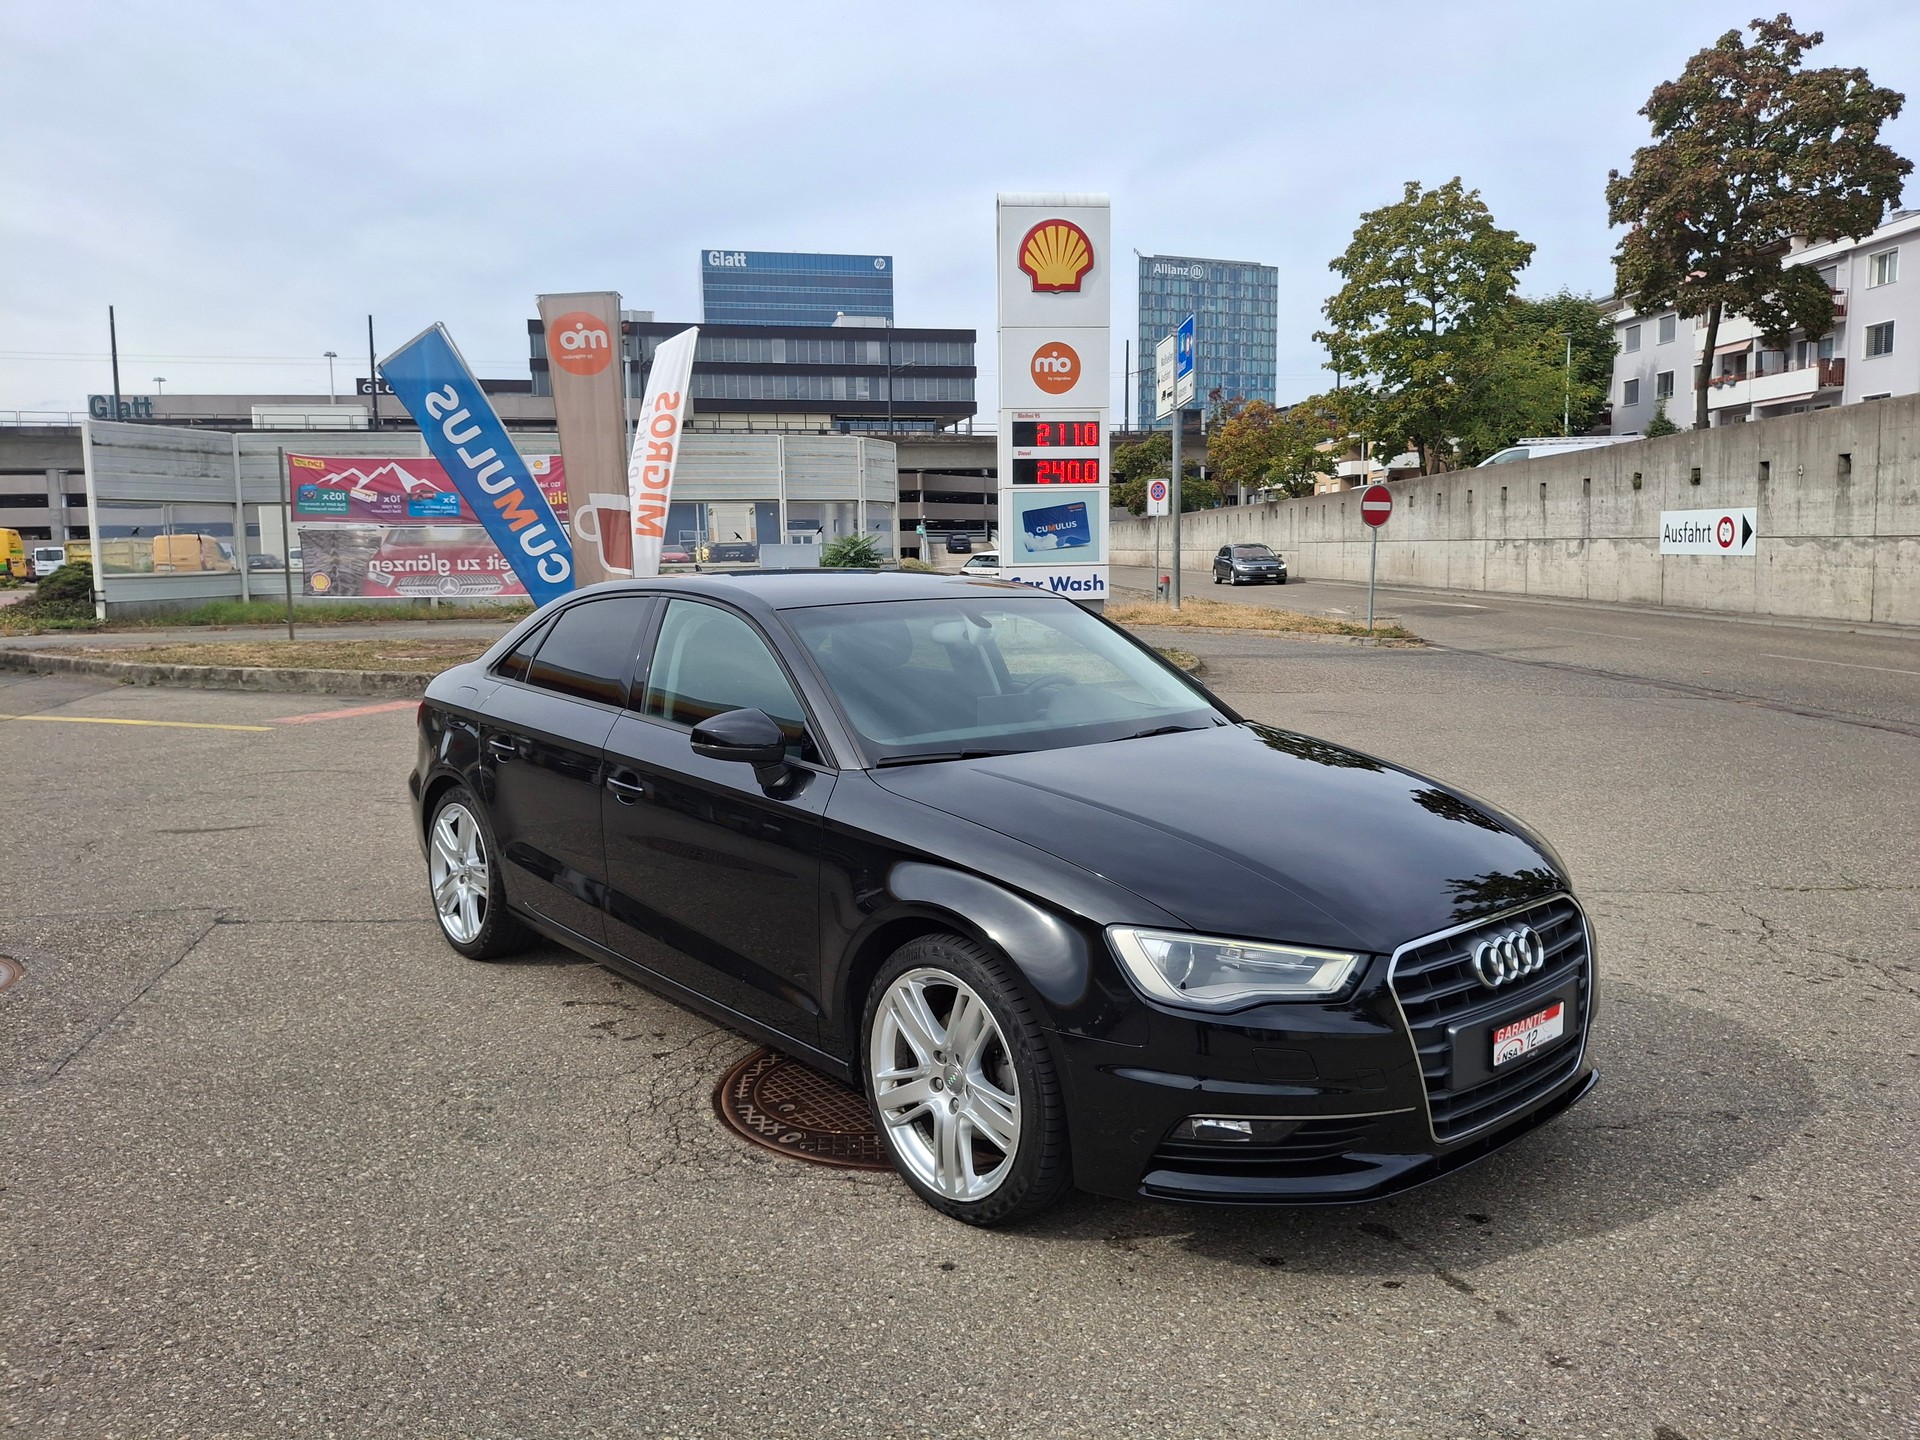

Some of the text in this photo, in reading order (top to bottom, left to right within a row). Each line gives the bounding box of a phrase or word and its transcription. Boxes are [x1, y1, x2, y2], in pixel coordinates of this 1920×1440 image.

[708, 250, 747, 267] Glatt
[875, 258, 885, 270] hp
[1153, 263, 1189, 276] Allianz
[1035, 351, 1072, 373] mio
[89, 394, 154, 419] Glatt
[1036, 423, 1098, 446] 211.0
[1037, 460, 1098, 484] 240.0
[1036, 520, 1078, 534] CUMULUS
[1663, 521, 1712, 543] Ausfahrt
[1049, 574, 1104, 592] Wash
[1497, 1010, 1548, 1043] GARANTIE
[1525, 1029, 1538, 1050] 12
[1501, 1047, 1518, 1062] NSA
